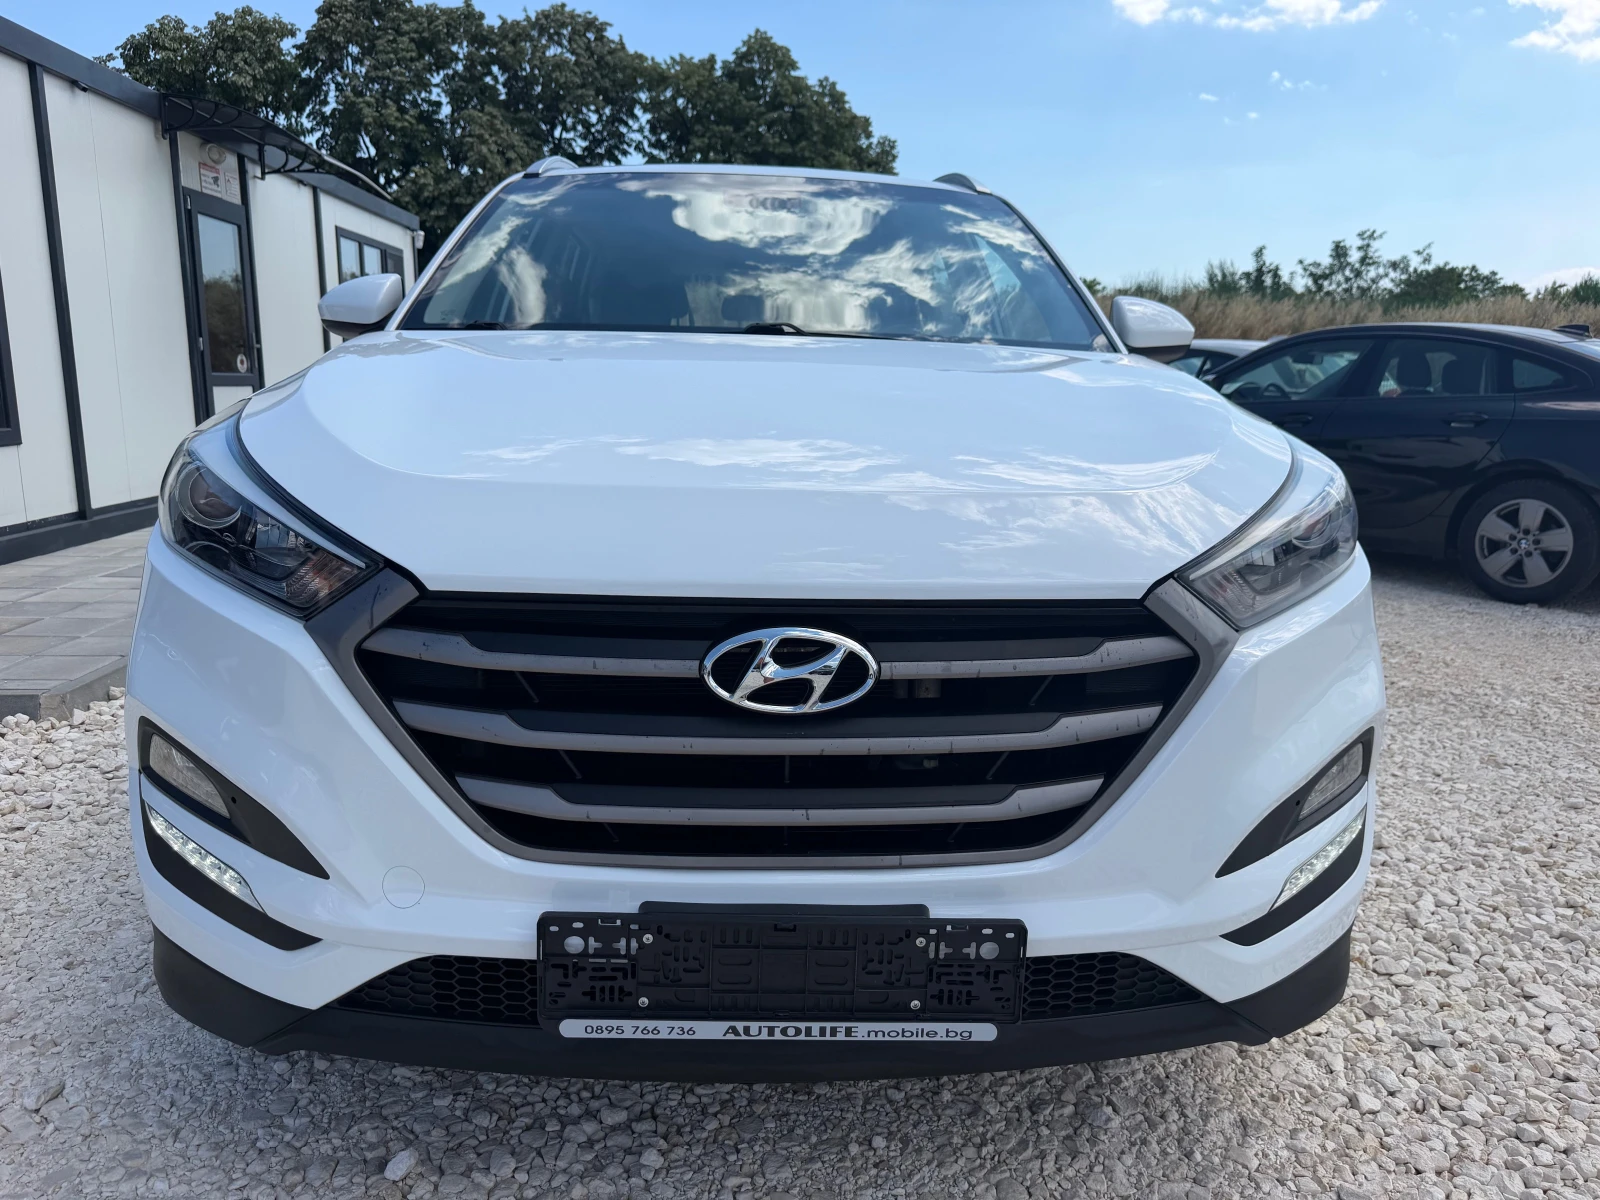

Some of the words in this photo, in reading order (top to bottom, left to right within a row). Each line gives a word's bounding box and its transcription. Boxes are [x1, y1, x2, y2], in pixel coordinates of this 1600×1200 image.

[584, 1024, 625, 1035] 0895
[630, 1025, 661, 1036] 766
[666, 1026, 697, 1037] 736
[722, 1024, 973, 1041] AUTOLIFE.mobile.bg
